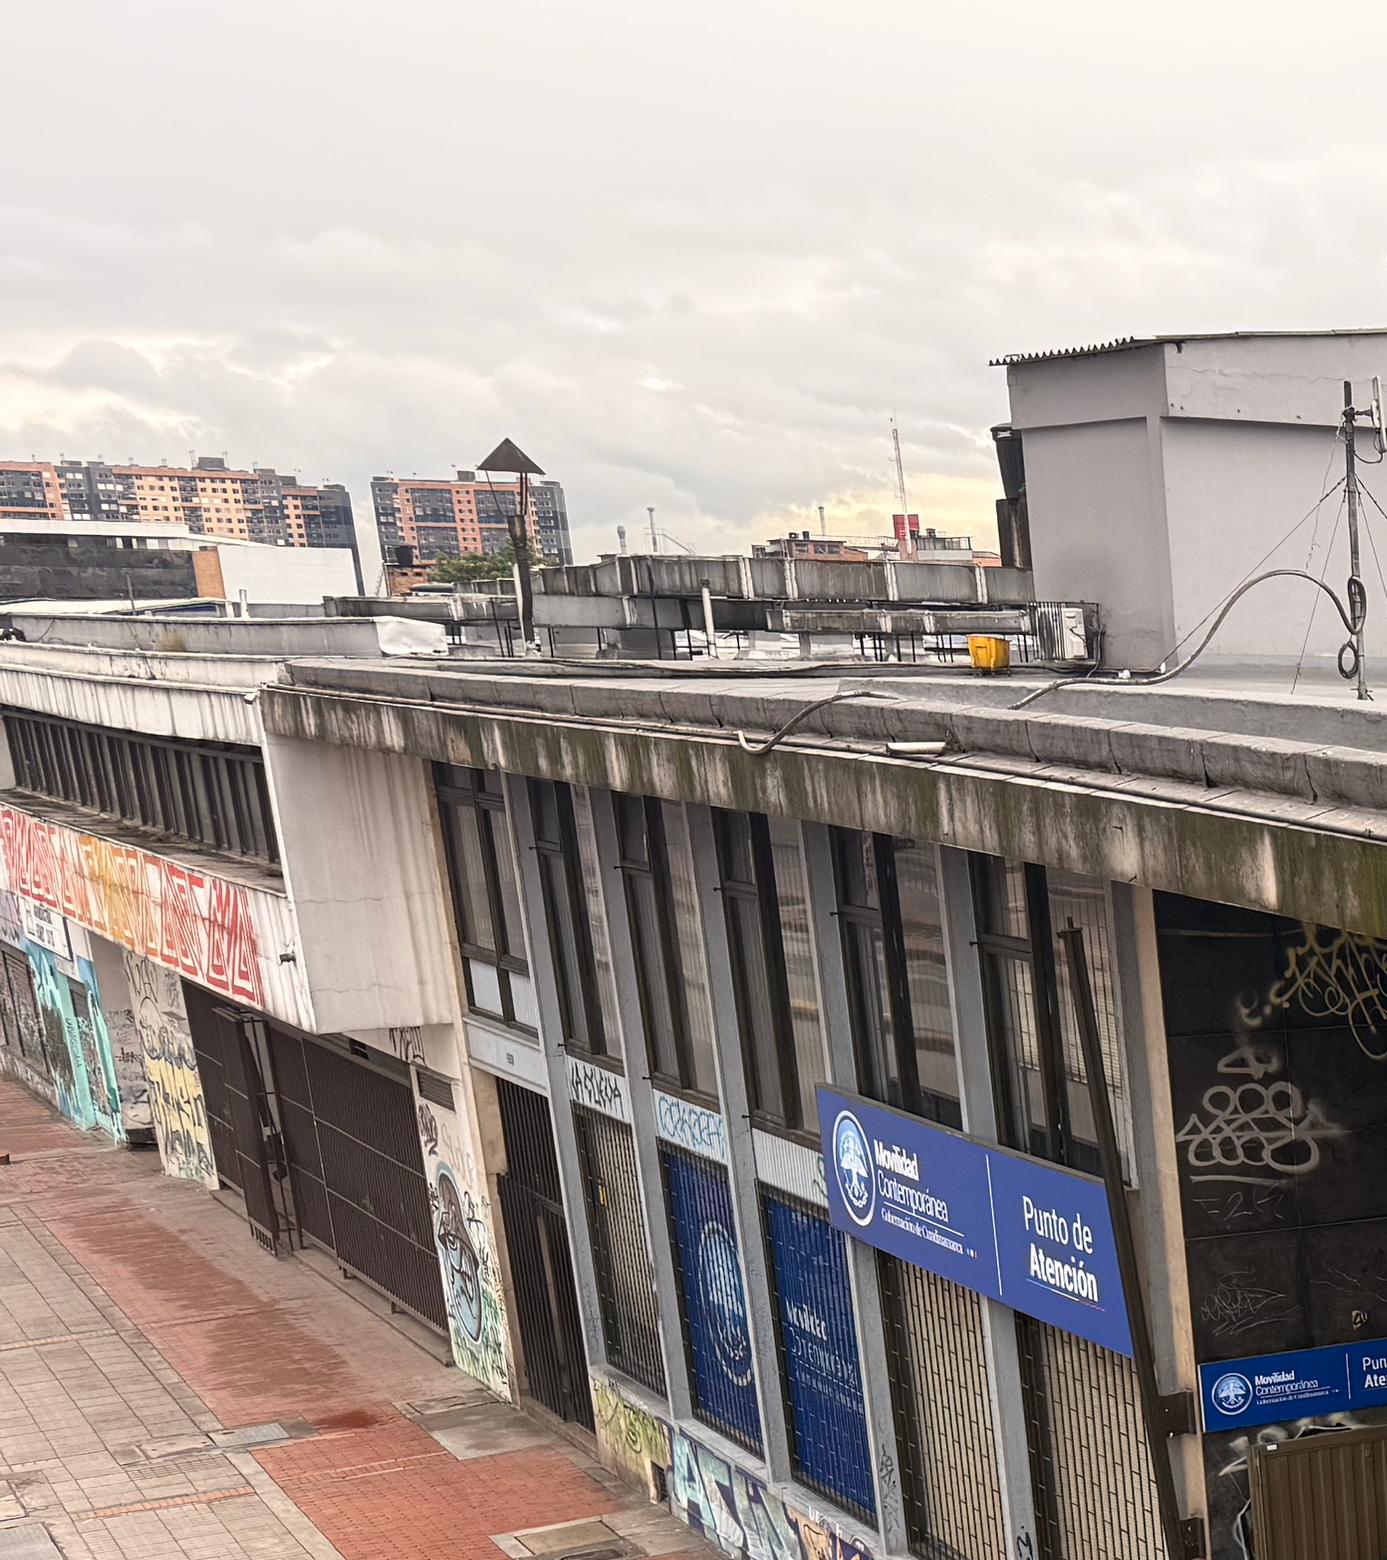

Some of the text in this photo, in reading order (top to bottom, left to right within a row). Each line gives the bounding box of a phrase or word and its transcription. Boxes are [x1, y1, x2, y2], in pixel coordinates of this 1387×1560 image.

[873, 1138, 920, 1181] Movilidad
[877, 1170, 949, 1223] Contemporánea
[1022, 1195, 1094, 1255] Punto de
[1029, 1242, 1098, 1302] Atención
[1254, 1369, 1295, 1387] Movilidad
[1255, 1378, 1319, 1397] Contemporánea
